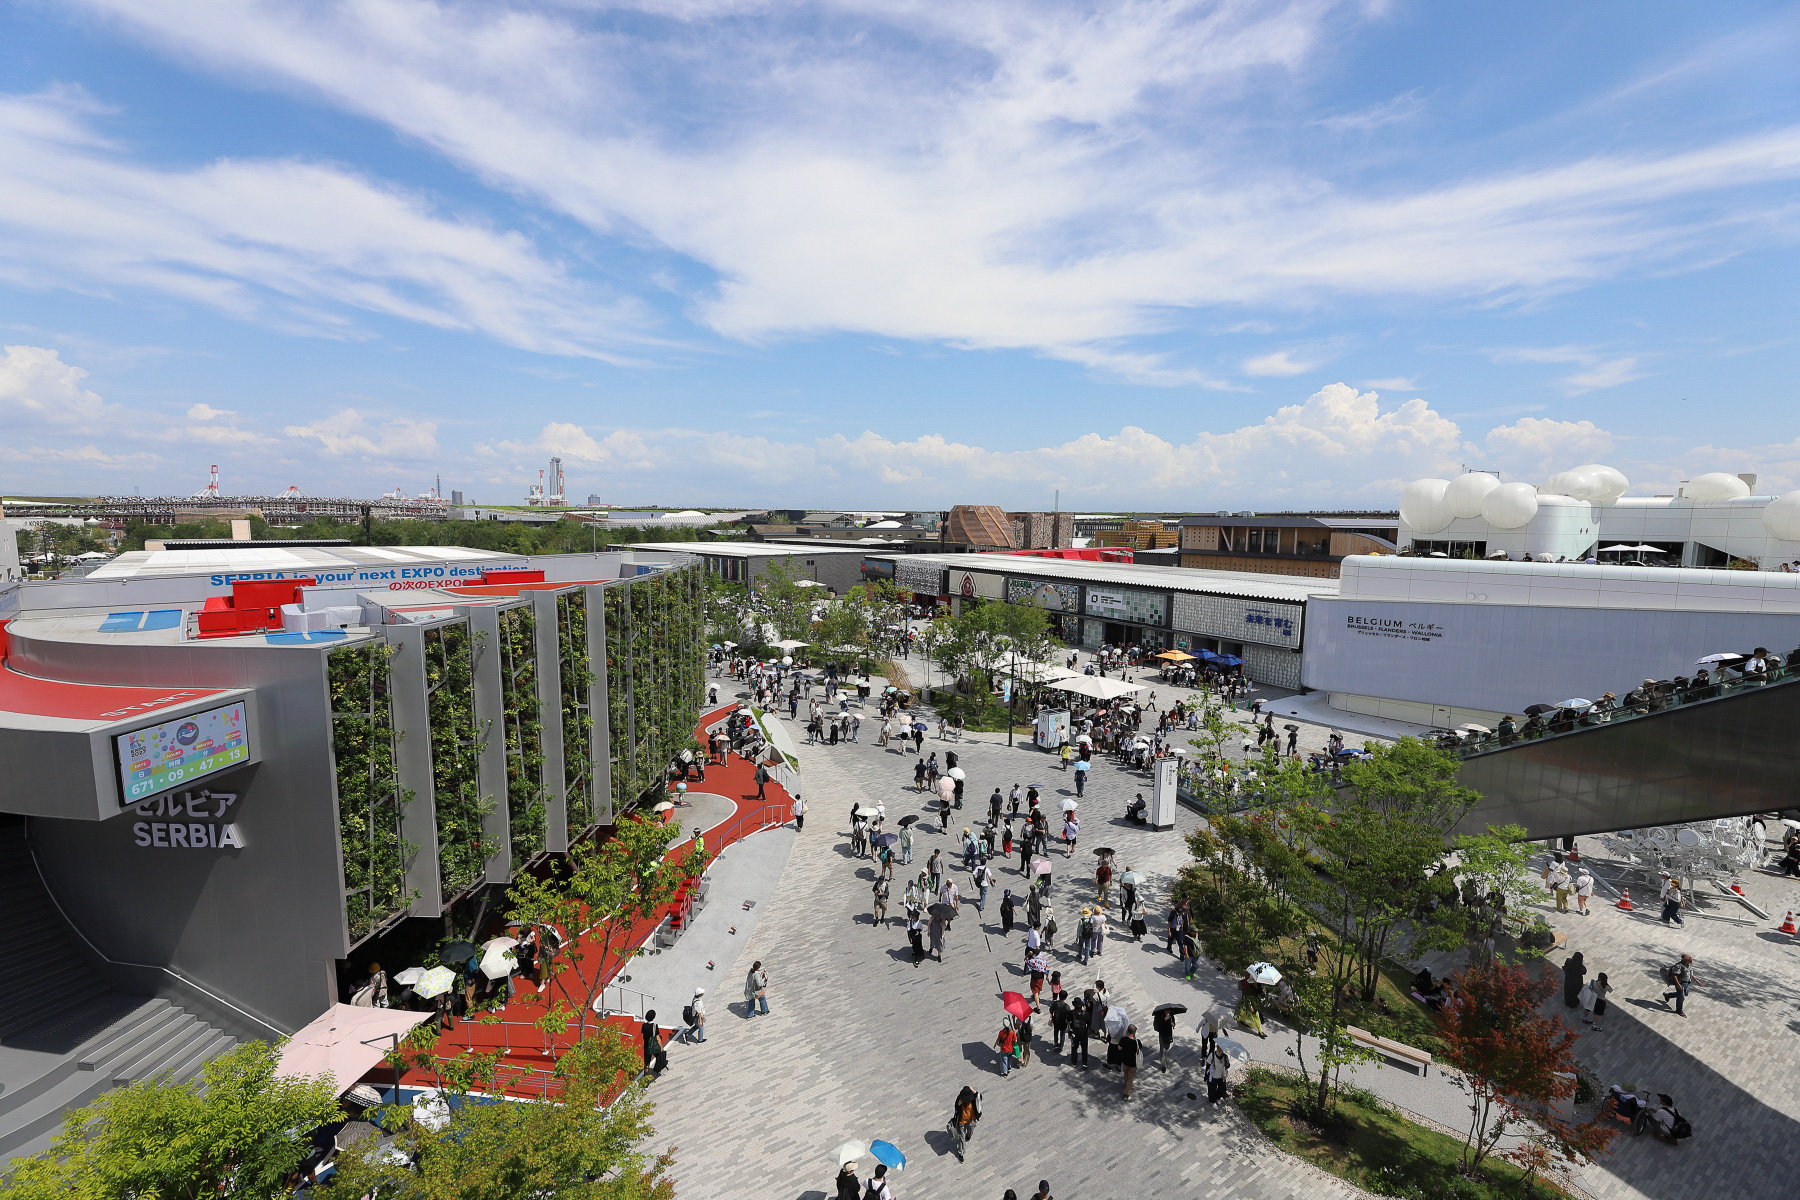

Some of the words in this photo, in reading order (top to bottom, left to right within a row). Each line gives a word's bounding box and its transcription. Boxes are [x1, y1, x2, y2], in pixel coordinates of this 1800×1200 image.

[315, 572, 354, 584] your
[359, 569, 396, 580] next
[401, 567, 445, 579] EXPO
[389, 579, 463, 591] の次のEXPO
[1347, 616, 1403, 628] BELGIUM
[1409, 623, 1444, 631] ベルギー
[1412, 630, 1443, 638] WALLONIA
[131, 779, 154, 795] 671
[168, 768, 184, 782] 09
[199, 758, 214, 771] 47
[229, 749, 241, 760] 13
[133, 822, 243, 849] SERBIA
